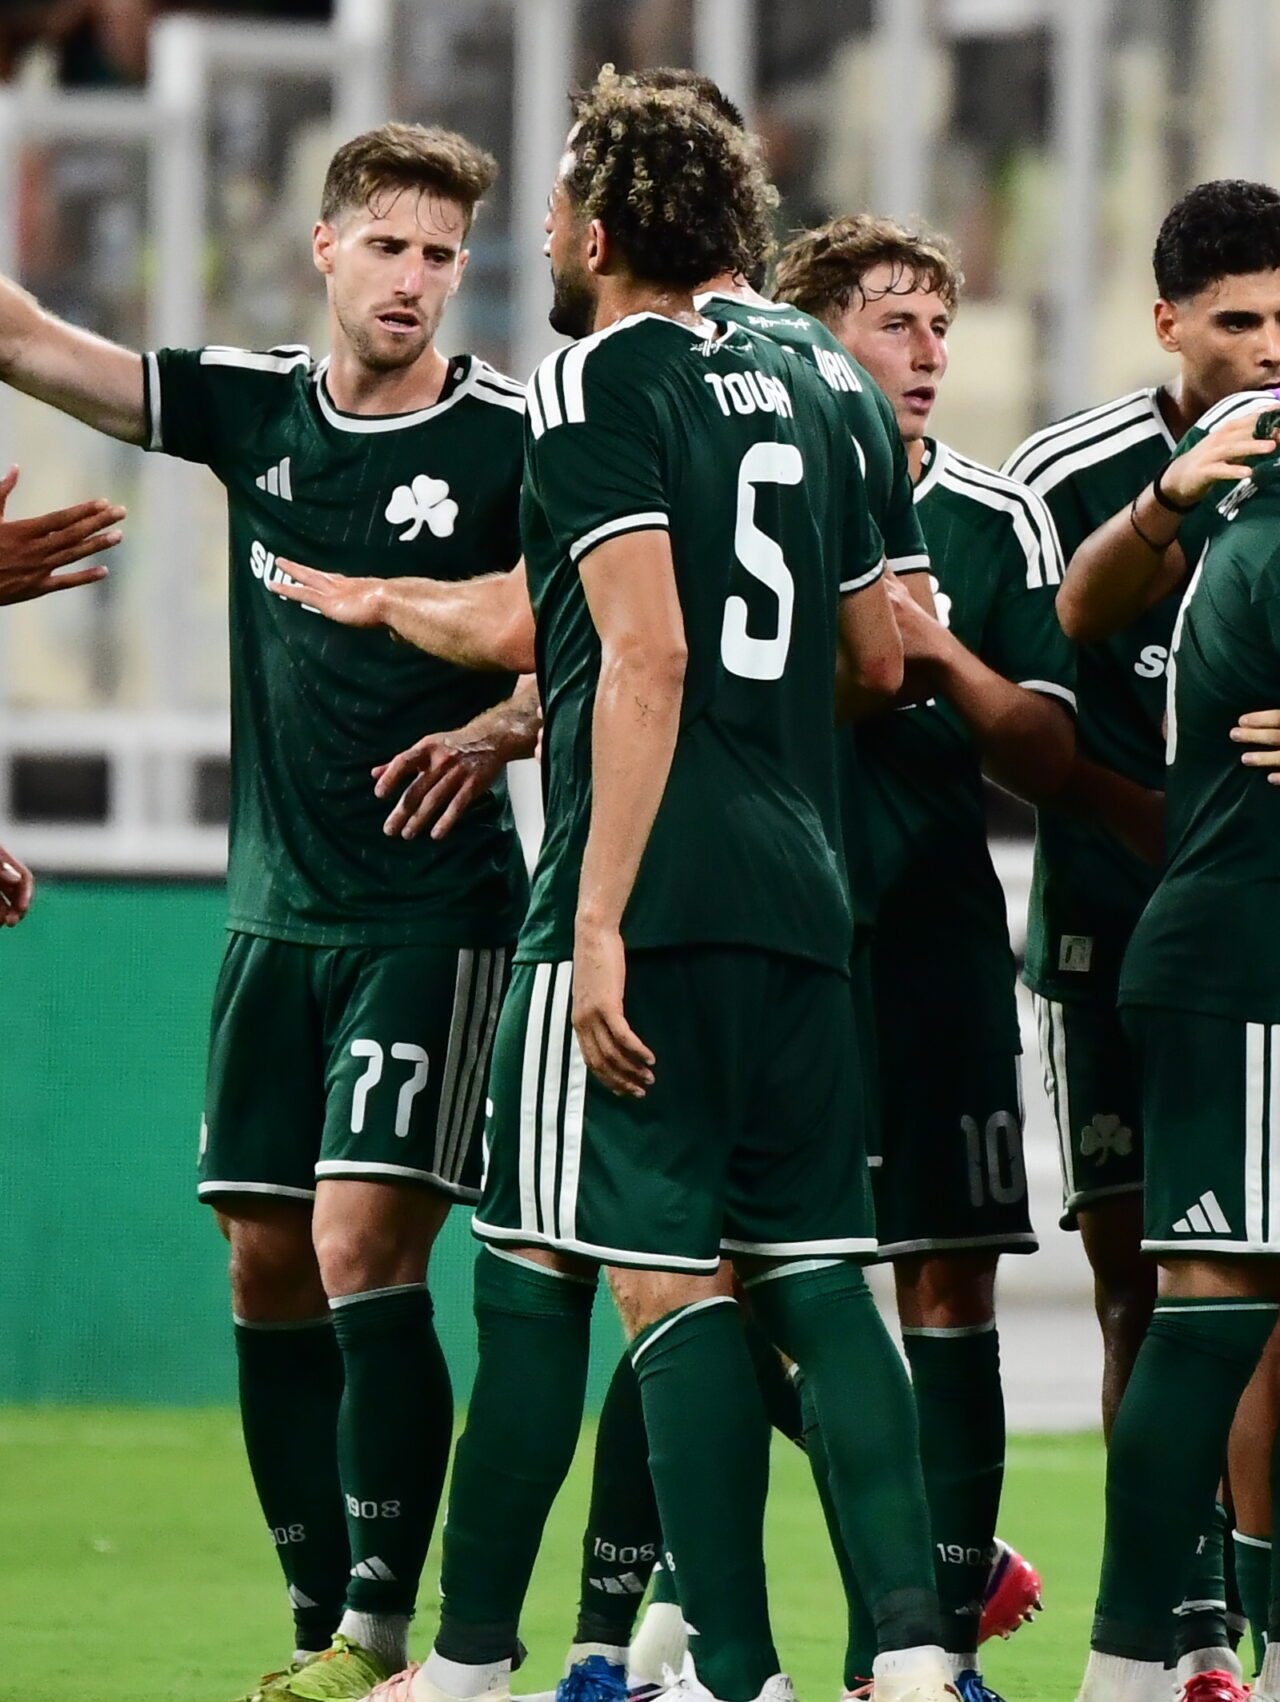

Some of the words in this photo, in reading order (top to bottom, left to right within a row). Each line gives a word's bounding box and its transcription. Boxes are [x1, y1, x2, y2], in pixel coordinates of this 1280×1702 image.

[720, 442, 803, 680] 5
[351, 1039, 429, 1138] 77
[960, 1110, 1026, 1207] 10
[593, 1537, 656, 1564] 1908
